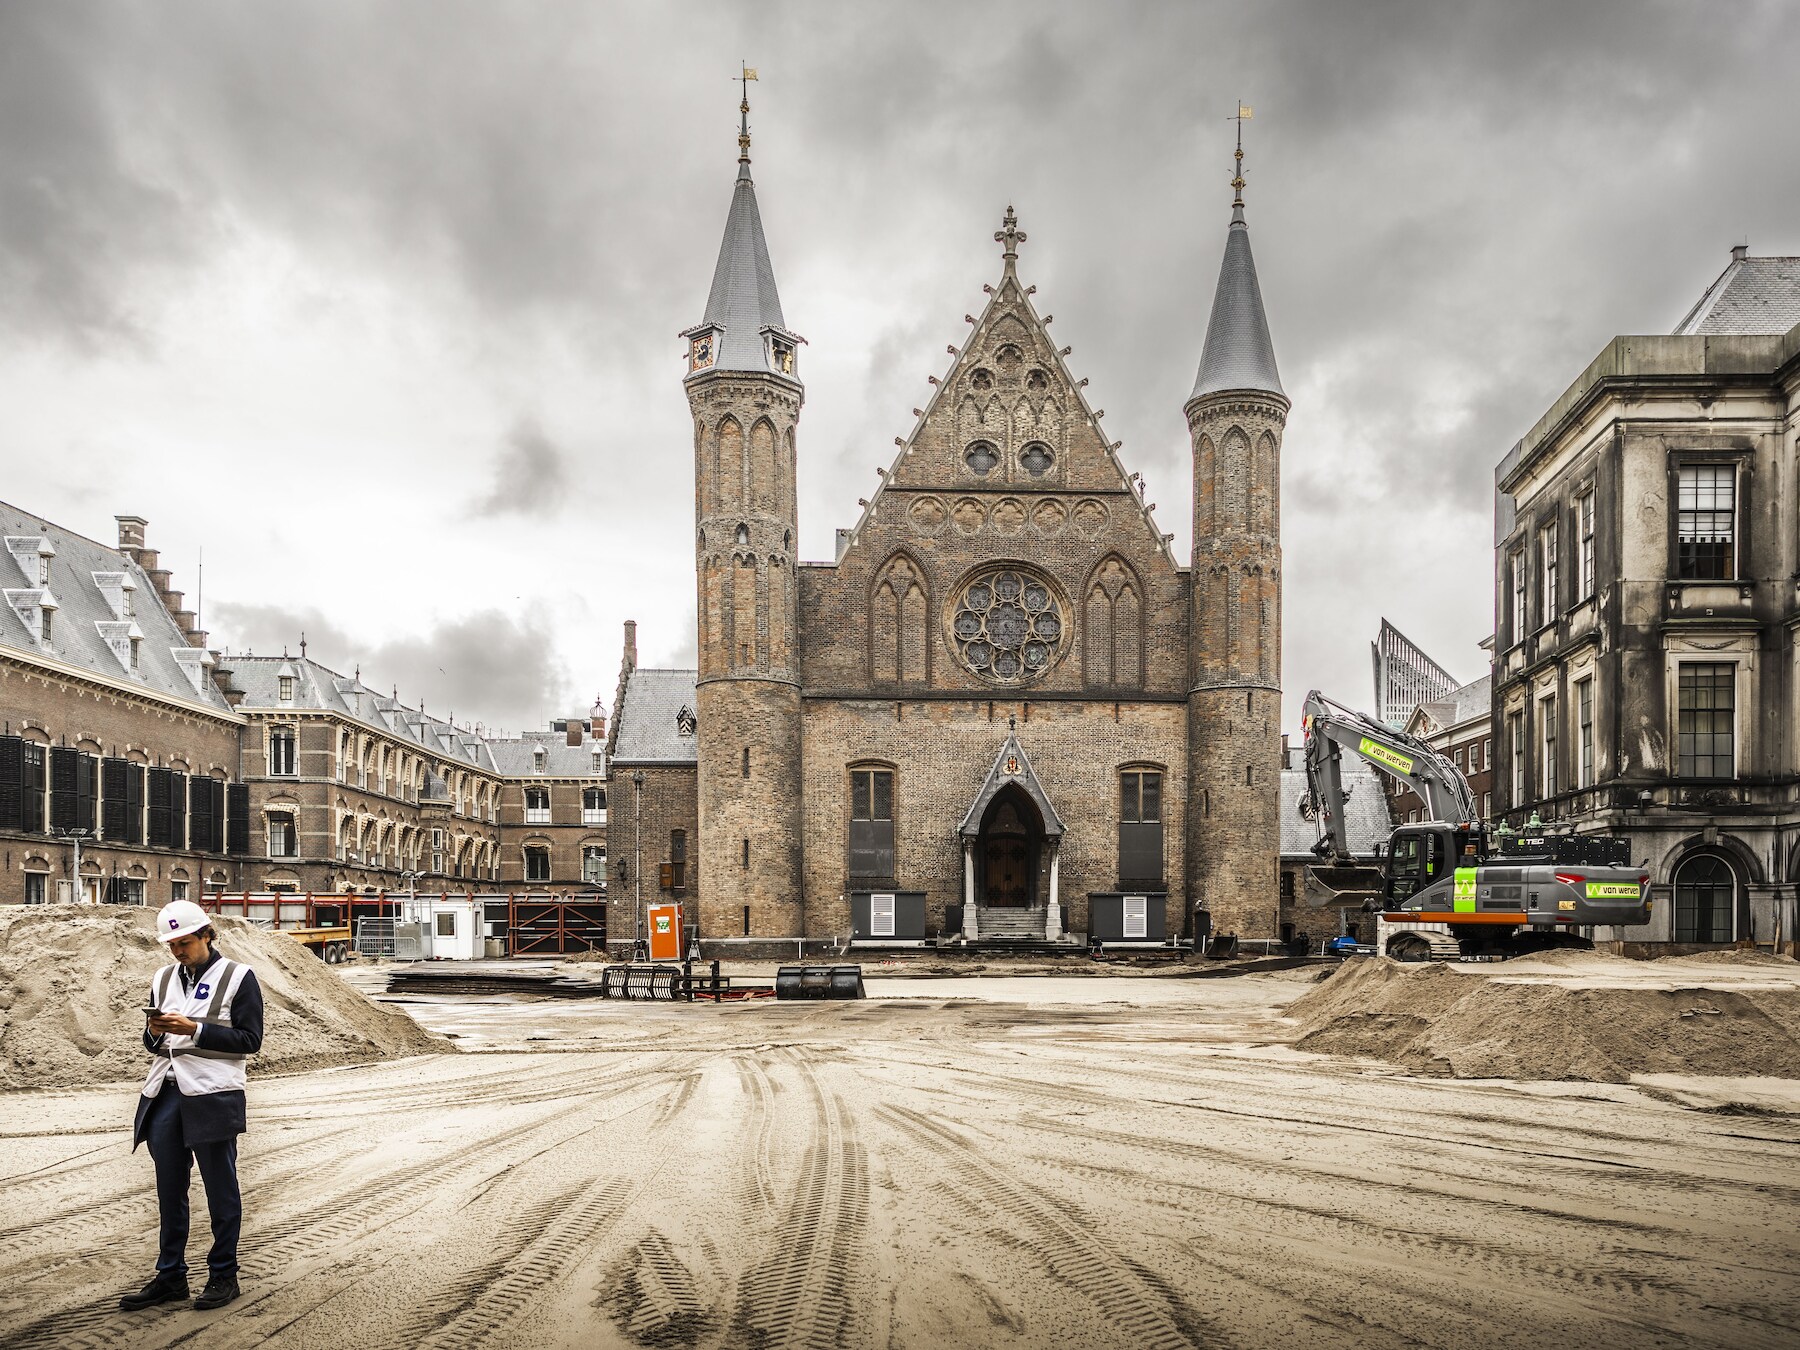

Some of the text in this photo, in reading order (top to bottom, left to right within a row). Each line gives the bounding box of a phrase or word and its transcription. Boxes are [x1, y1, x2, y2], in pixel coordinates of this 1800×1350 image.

[1373, 746, 1385, 757] van
[1386, 754, 1411, 771] werven
[1603, 886, 1617, 894] van
[1618, 886, 1639, 895] werven
